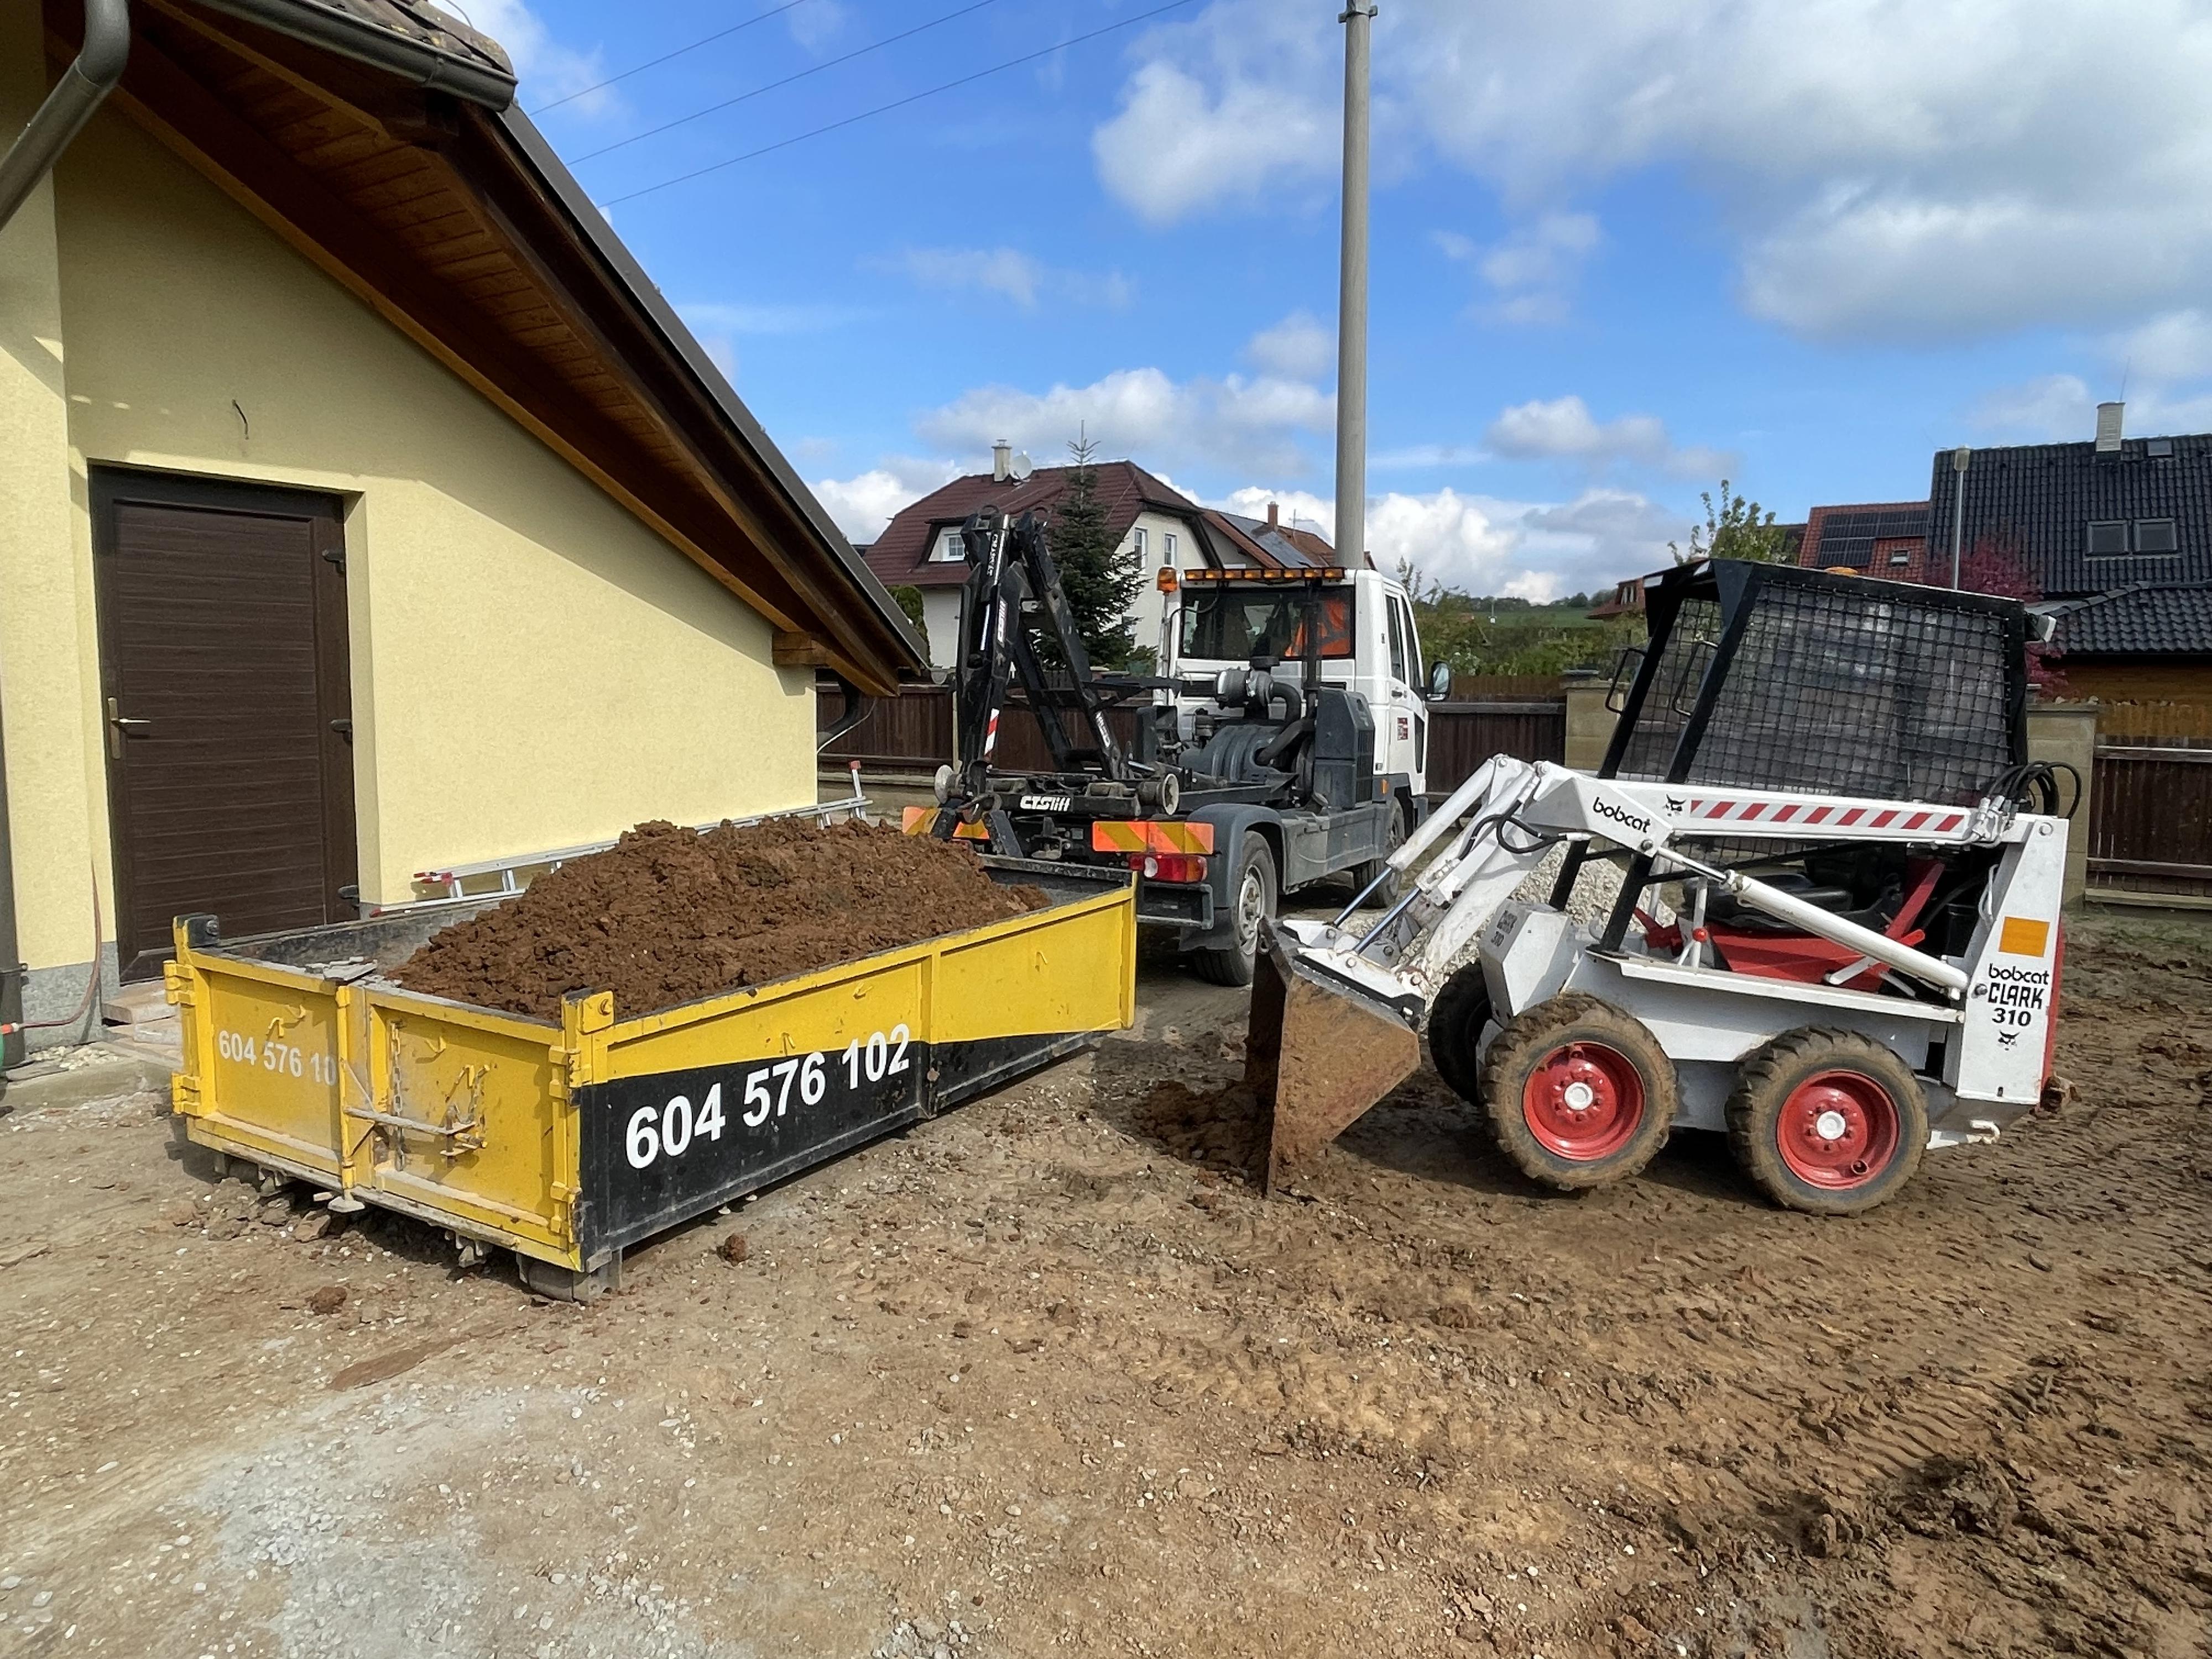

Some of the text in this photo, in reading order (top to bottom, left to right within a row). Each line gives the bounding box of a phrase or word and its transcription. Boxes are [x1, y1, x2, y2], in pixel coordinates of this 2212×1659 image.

[1593, 797, 1651, 833] bobcat
[1989, 963, 2049, 985] bobcat
[1987, 982, 2044, 1009] CLARK
[1992, 1008, 2031, 1027] 310
[219, 1030, 337, 1086] 604 576 10
[625, 1024, 910, 1169] 604 576 102
